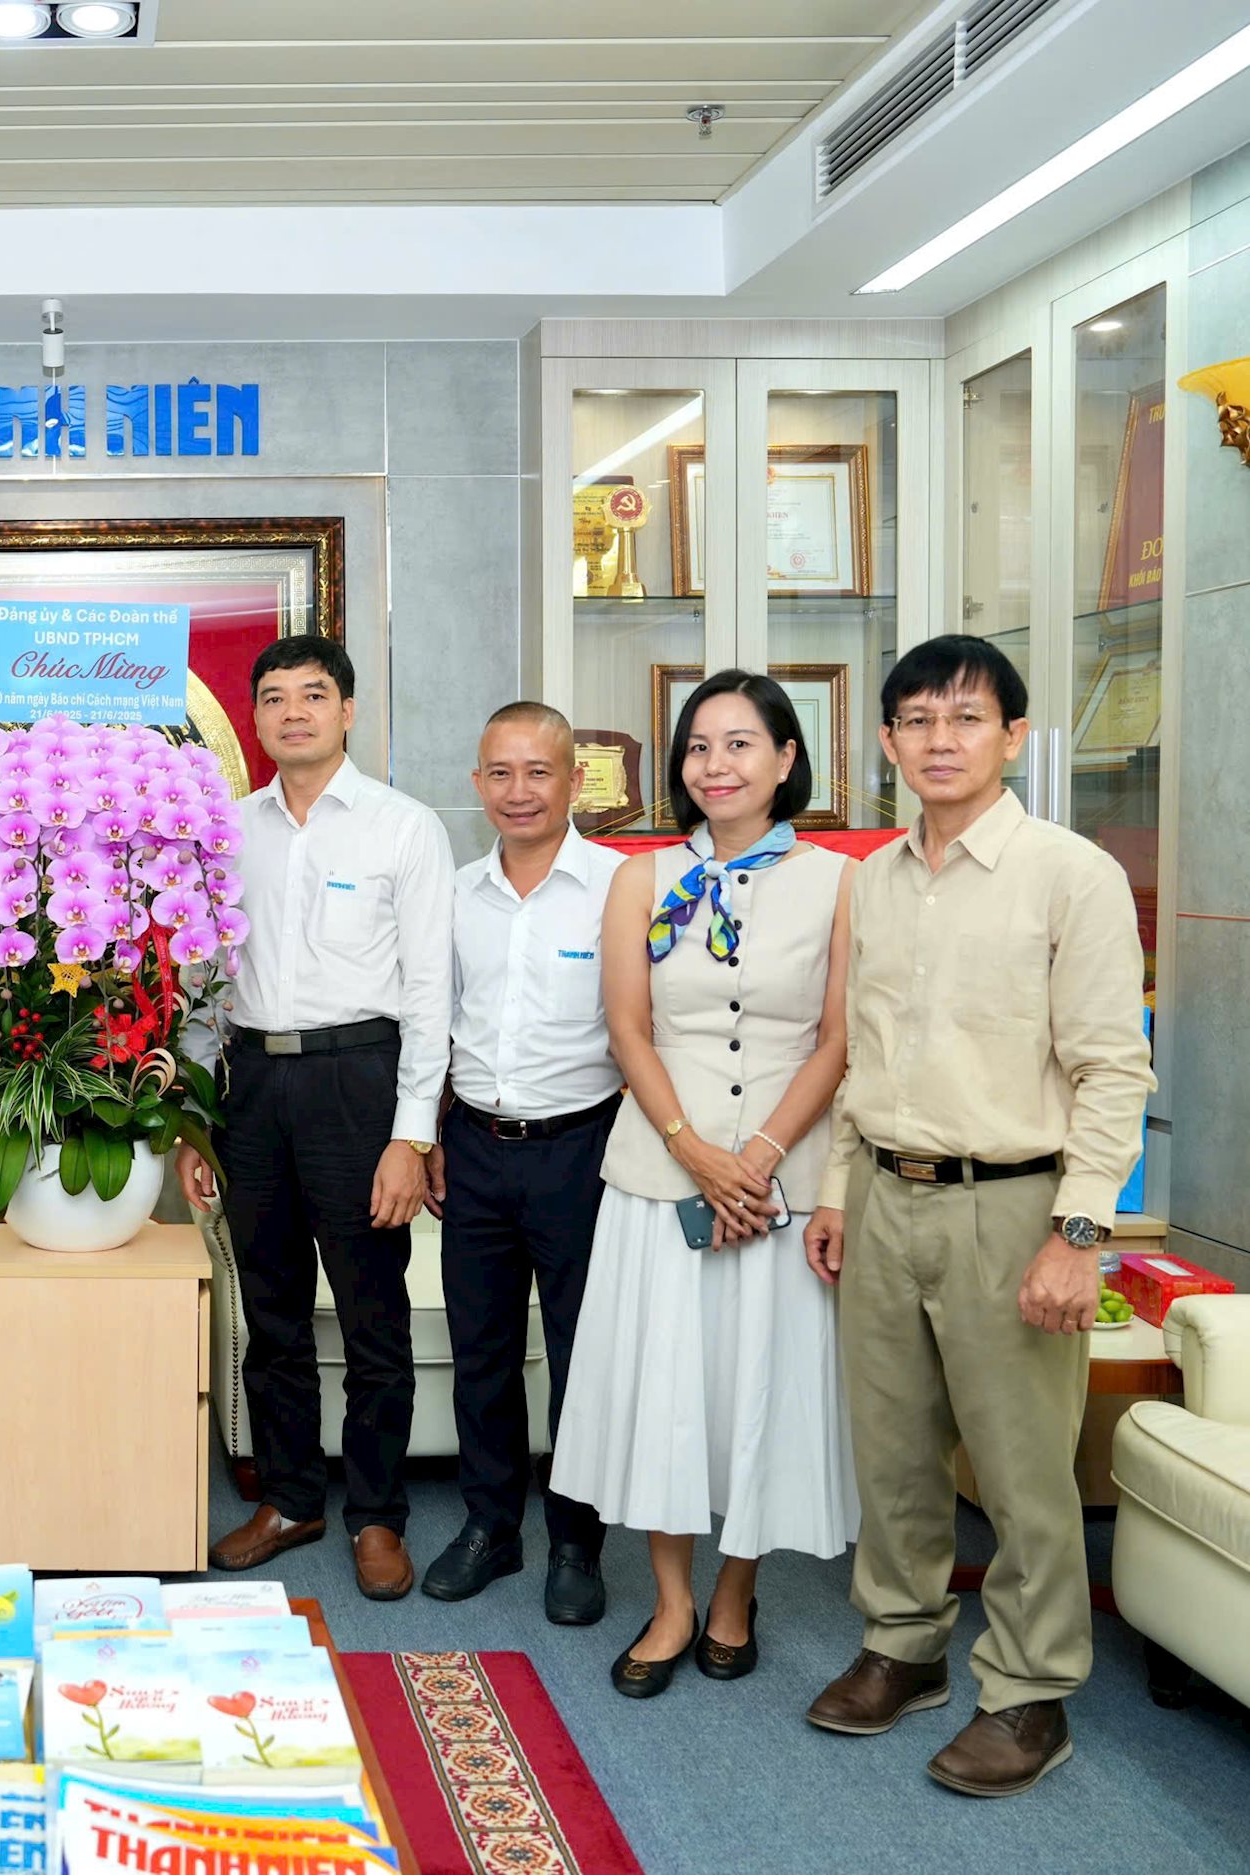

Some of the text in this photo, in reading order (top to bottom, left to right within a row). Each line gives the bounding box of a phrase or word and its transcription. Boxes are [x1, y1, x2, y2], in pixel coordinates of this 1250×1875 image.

[106, 376, 259, 457] NIÊN
[40, 607, 59, 624] ủy
[62, 609, 73, 622] &
[77, 608, 106, 623] Các
[109, 609, 150, 624] Đoàn
[153, 608, 178, 624] thể
[34, 632, 139, 646] UBND TPHCM
[10, 650, 170, 690] Chúc Mừng
[4, 692, 25, 704] năm
[27, 692, 49, 707] ngày
[51, 692, 69, 705] Báo
[70, 692, 85, 705] chí
[87, 693, 111, 705] Cách
[113, 695, 139, 709] mạng
[141, 694, 159, 709] Việt
[161, 695, 183, 707] Nam
[91, 711, 142, 720] 21/6/2025
